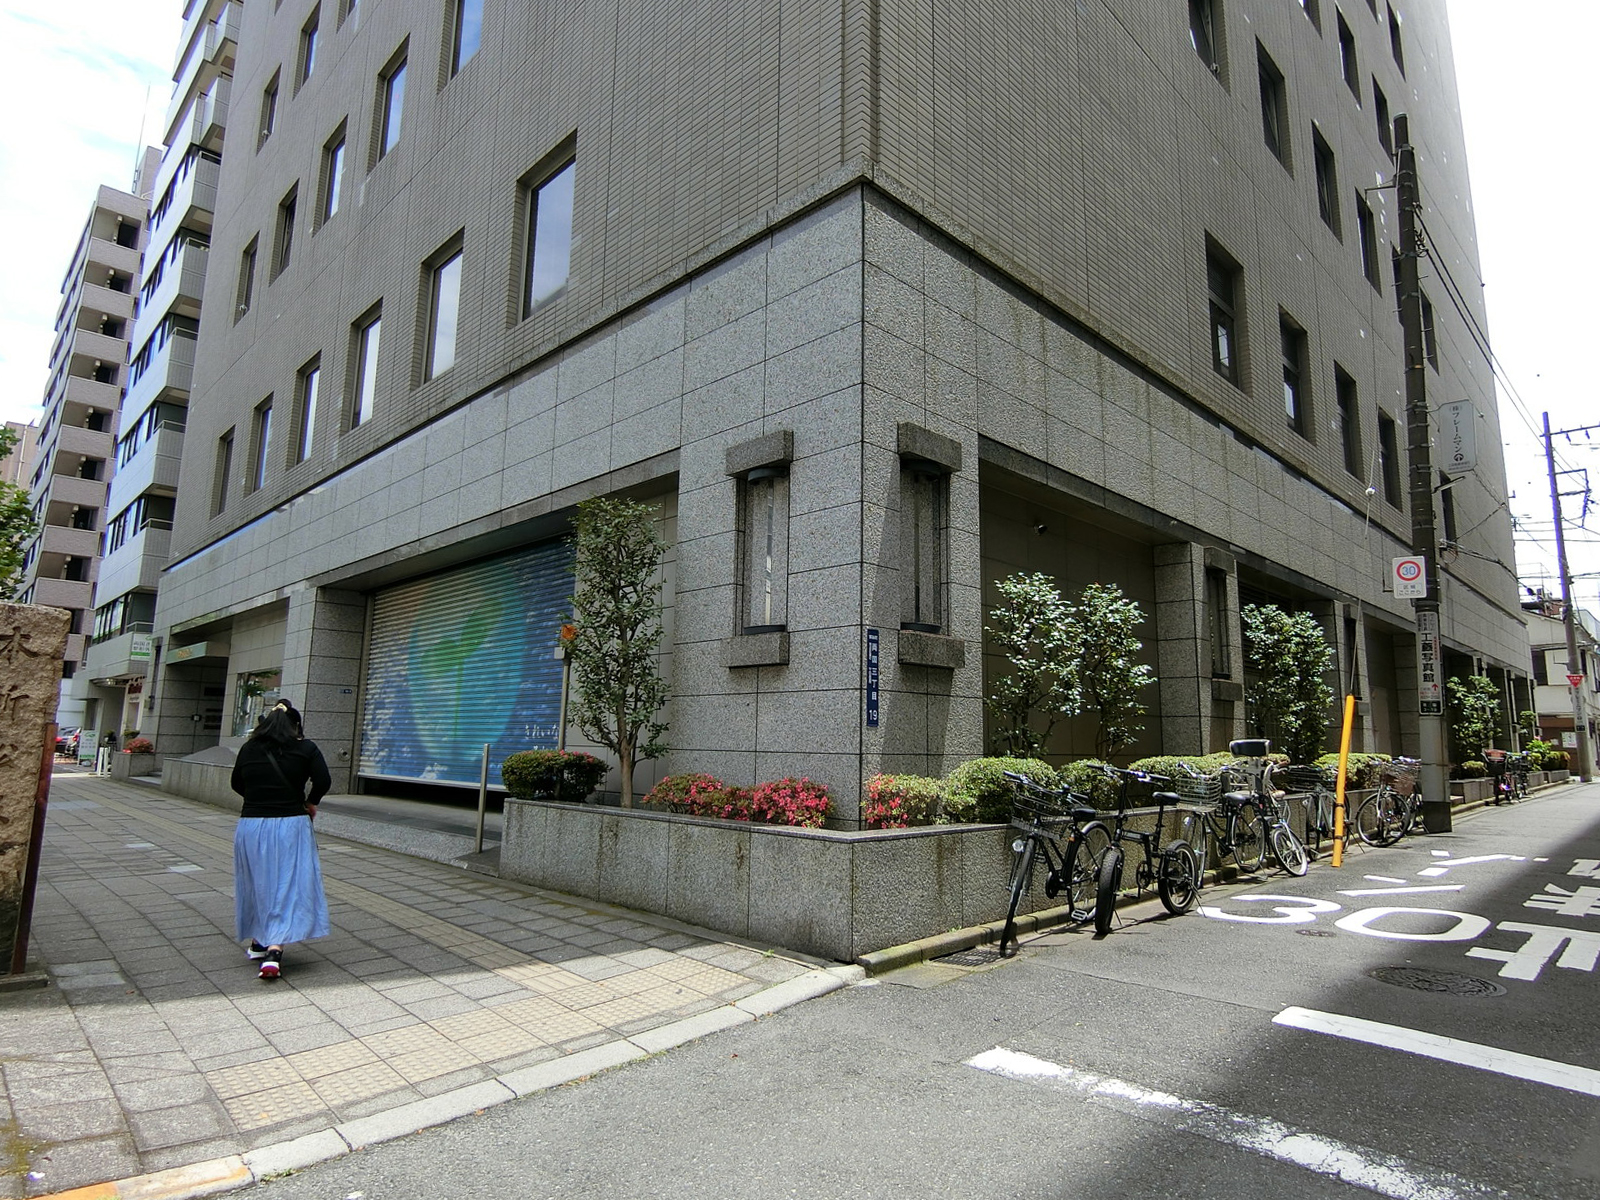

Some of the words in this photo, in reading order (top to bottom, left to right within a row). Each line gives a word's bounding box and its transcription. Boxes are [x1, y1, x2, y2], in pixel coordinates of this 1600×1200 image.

[1401, 565, 1416, 576] 30
[868, 709, 878, 721] 19
[1197, 895, 1492, 942] 30
